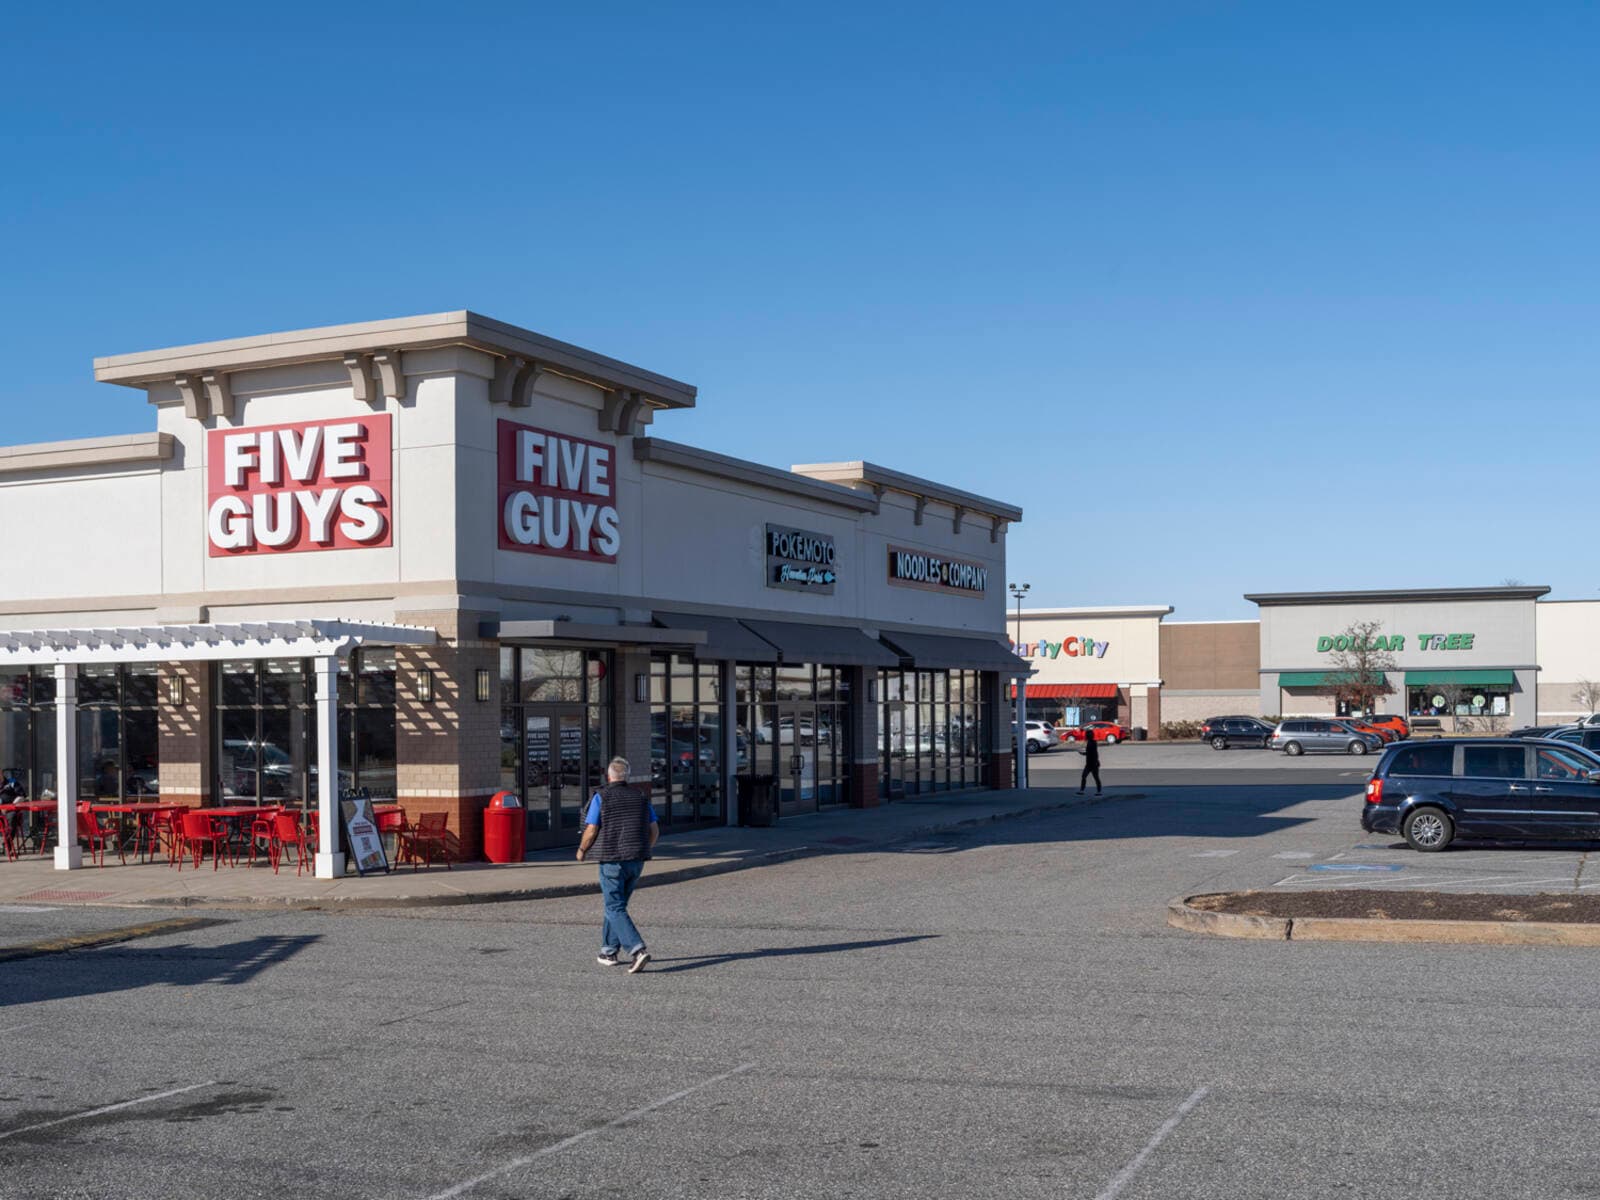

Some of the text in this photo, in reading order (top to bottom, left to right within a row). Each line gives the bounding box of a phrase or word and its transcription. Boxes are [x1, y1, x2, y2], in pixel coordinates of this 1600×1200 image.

[223, 423, 367, 486] FIVE
[516, 428, 610, 497] FIVE
[208, 485, 387, 549] GUYS
[504, 491, 621, 556] GUYS
[772, 531, 835, 565] POKEMOTO
[897, 552, 940, 584] NOODLES
[949, 562, 988, 591] COMPANY
[1008, 636, 1109, 660] arty City
[1418, 633, 1475, 650] TREE
